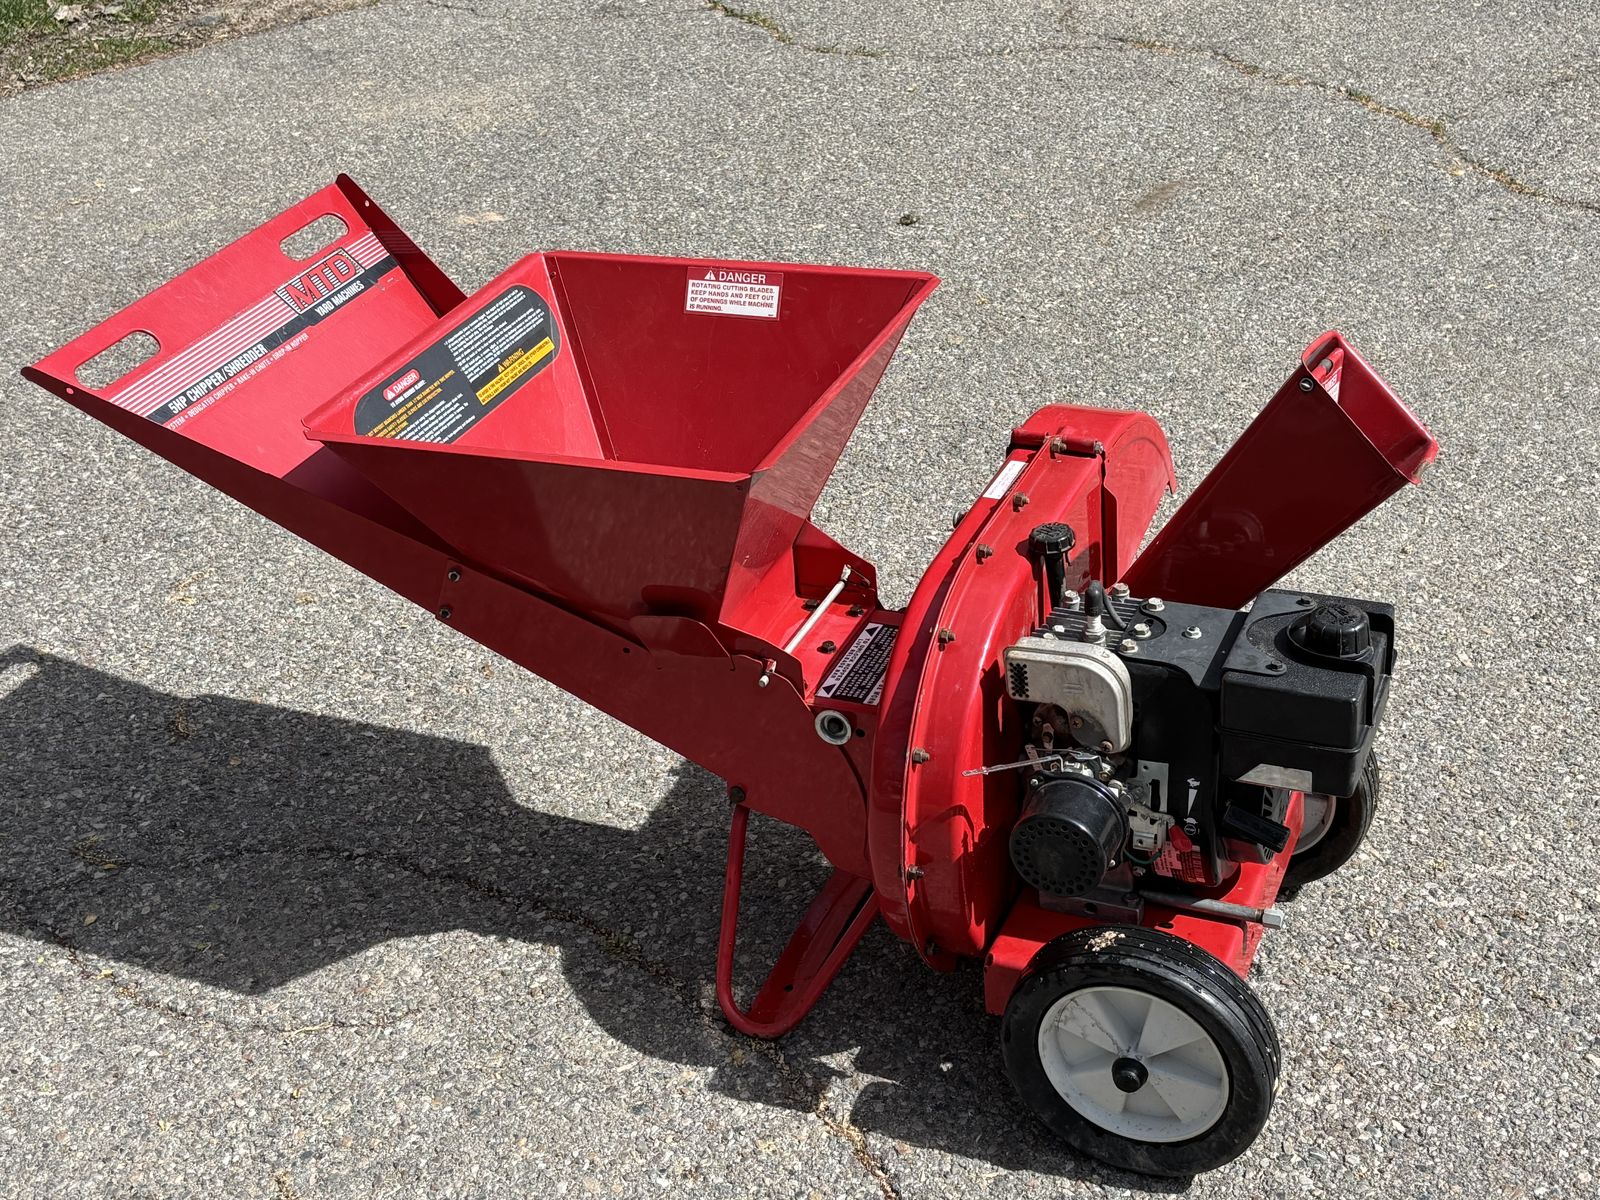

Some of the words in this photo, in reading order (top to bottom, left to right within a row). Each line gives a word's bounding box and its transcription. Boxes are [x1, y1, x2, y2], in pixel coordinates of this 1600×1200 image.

[286, 254, 357, 310] MTD
[692, 282, 720, 290] ROTATING
[719, 271, 766, 284] DANGER
[314, 299, 335, 317] YARD
[330, 279, 365, 306] MACHINES
[502, 348, 525, 367] WARNING
[167, 394, 189, 414] 5HP
[185, 342, 268, 402] CHIPPER/SHREDDER
[186, 395, 216, 418] DEDICATED
[212, 382, 235, 400] CHIPPER
[235, 367, 257, 385] RAKE-IN
[253, 357, 271, 372] CHUTE
[289, 332, 309, 348] HOPPER
[393, 372, 418, 394] DANGER
